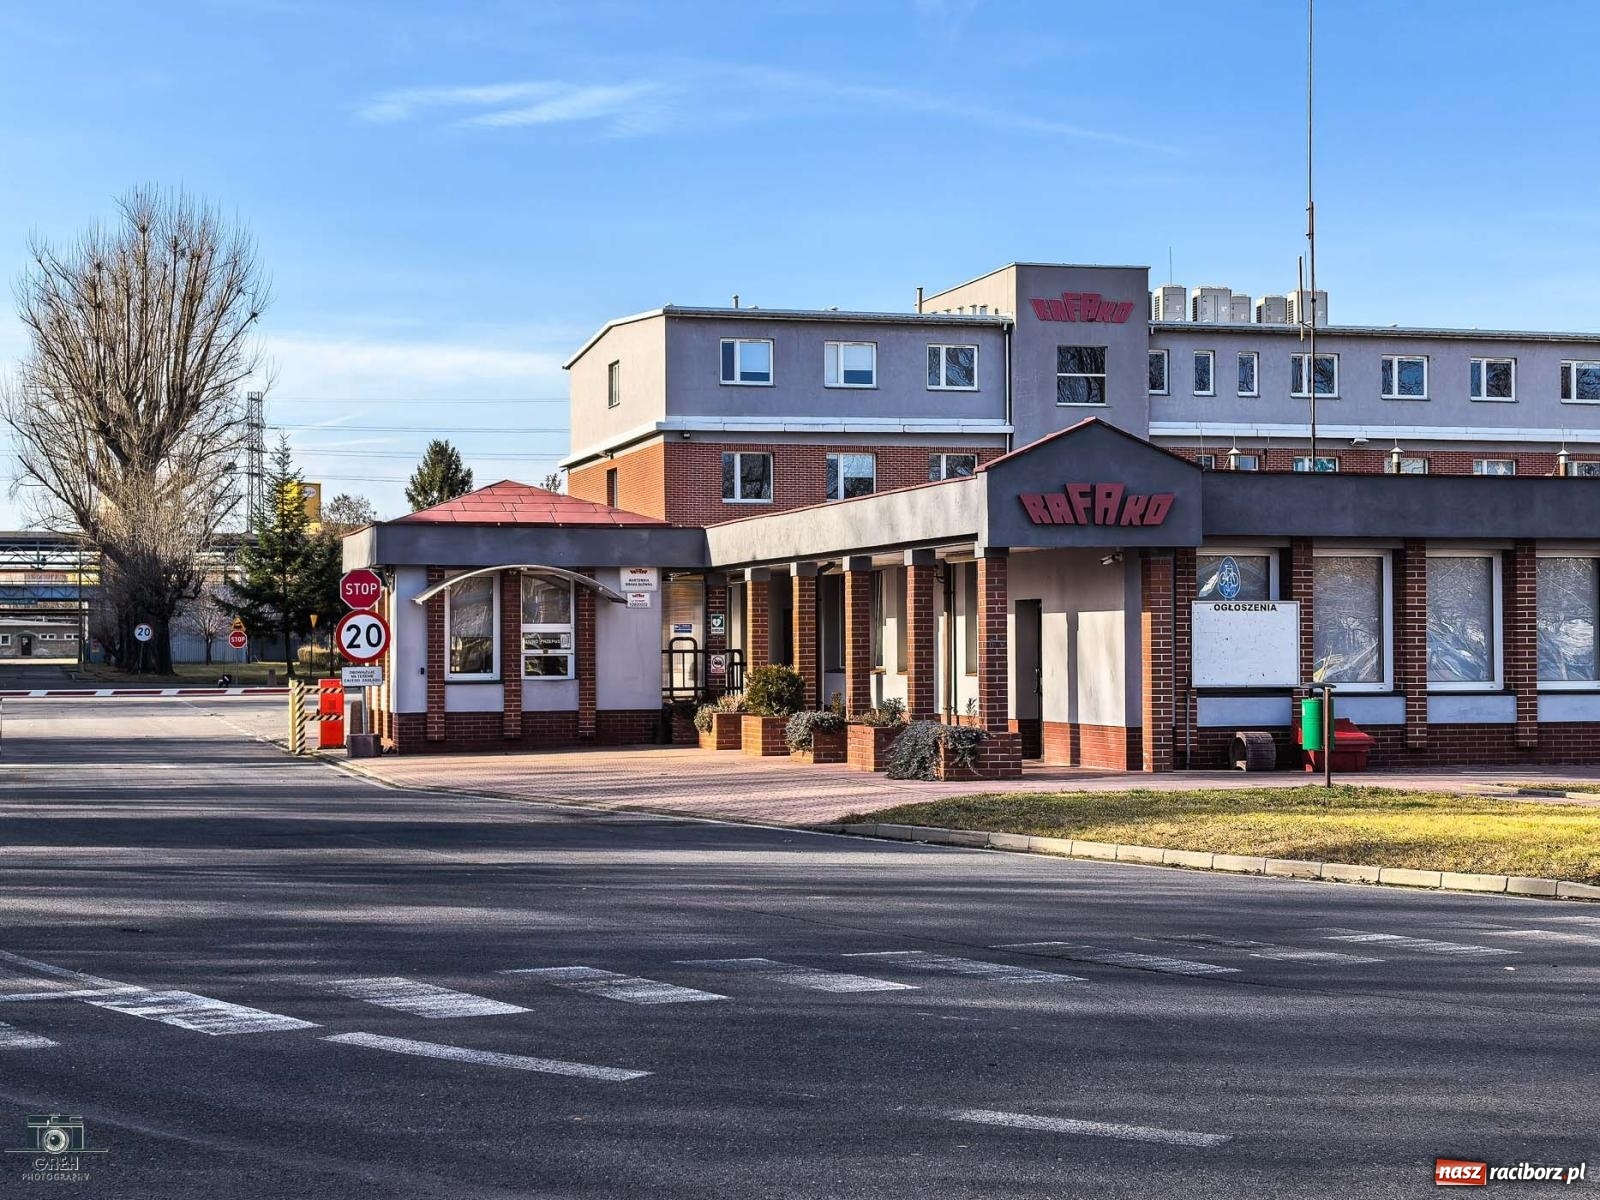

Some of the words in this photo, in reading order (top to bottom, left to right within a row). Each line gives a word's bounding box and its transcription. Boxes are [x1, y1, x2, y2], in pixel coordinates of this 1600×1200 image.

[1028, 290, 1136, 324] RAFAKO
[1019, 482, 1176, 527] RAFAKO
[345, 583, 378, 595] STOP
[1213, 603, 1277, 612] OGŁOSZENIA
[137, 627, 151, 637] 20
[345, 623, 382, 649] 20
